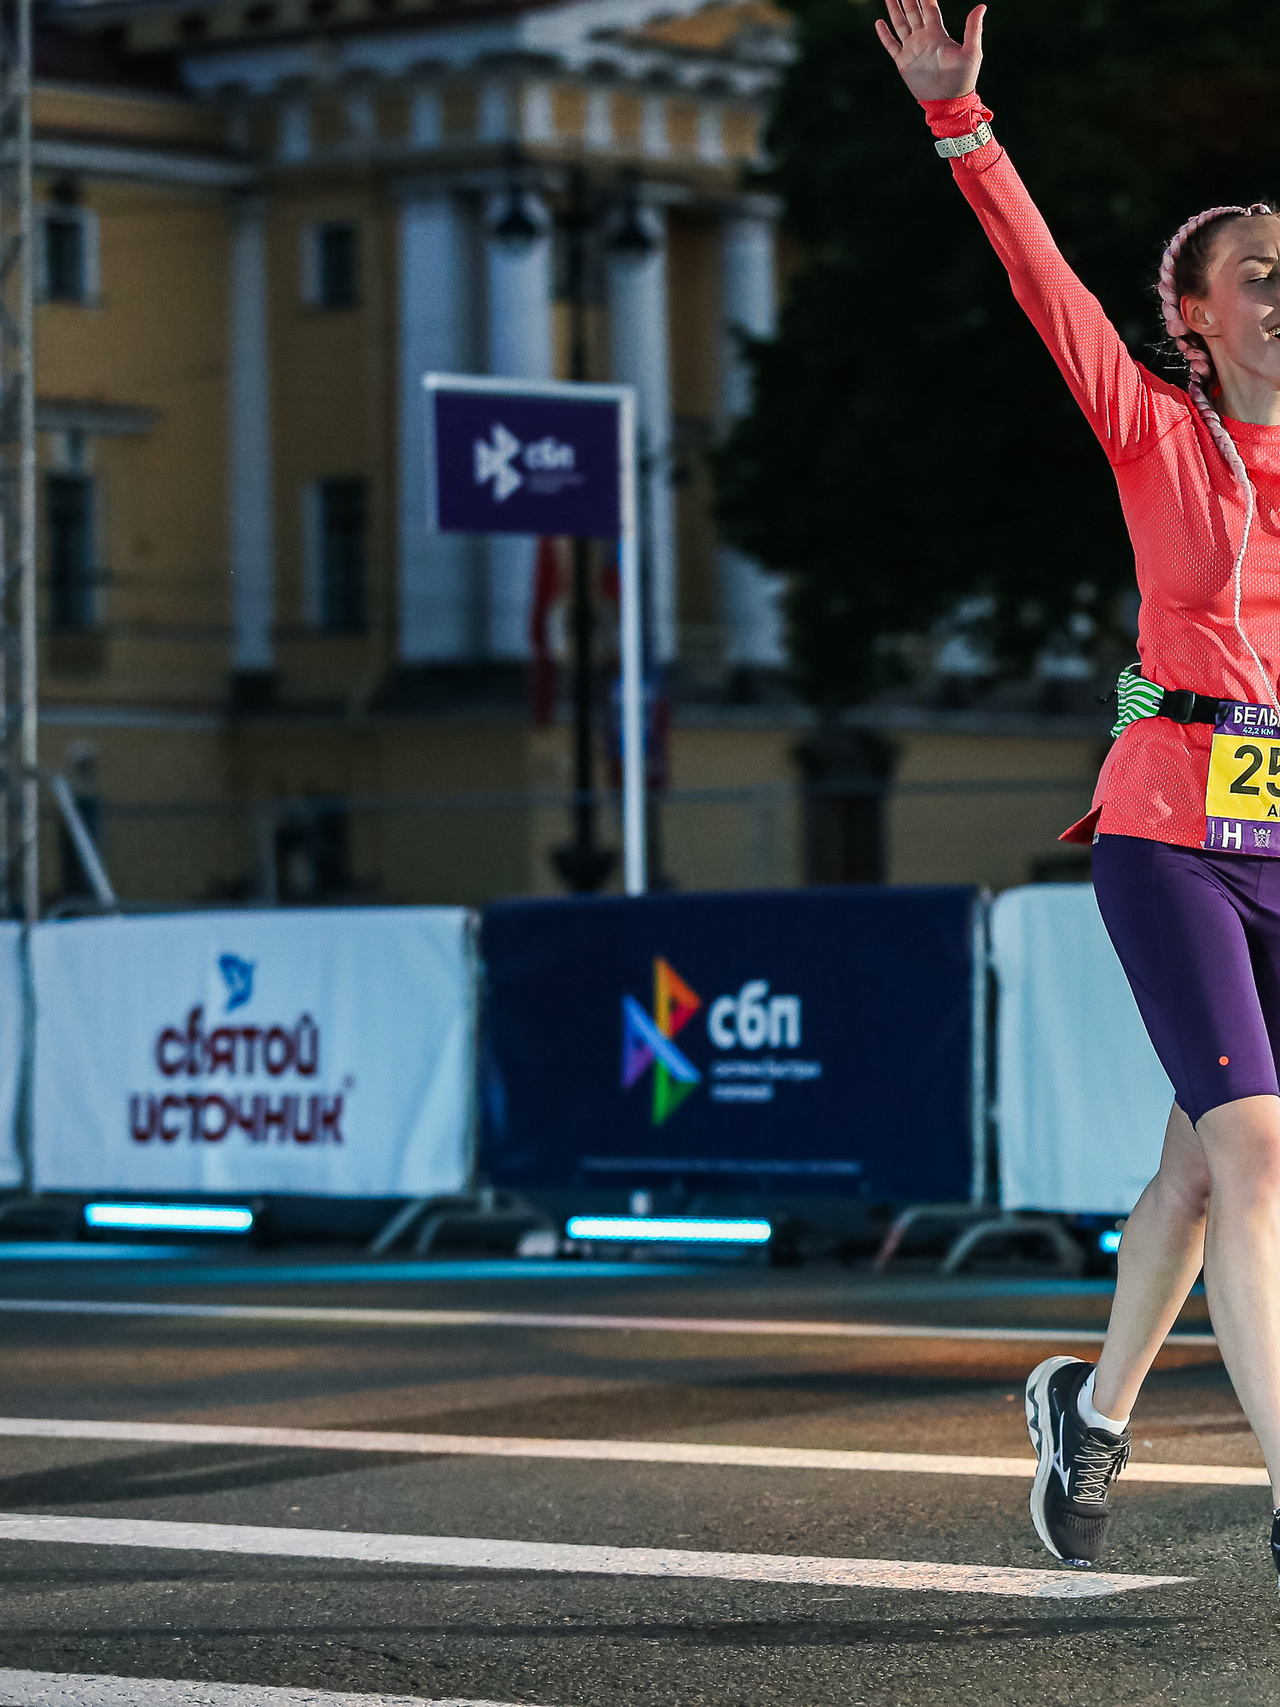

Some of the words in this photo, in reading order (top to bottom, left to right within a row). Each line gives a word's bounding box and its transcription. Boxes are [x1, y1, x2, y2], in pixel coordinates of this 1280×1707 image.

[1242, 726, 1260, 735] 42,2
[1261, 727, 1274, 736] КМ
[707, 978, 800, 1051] сбп
